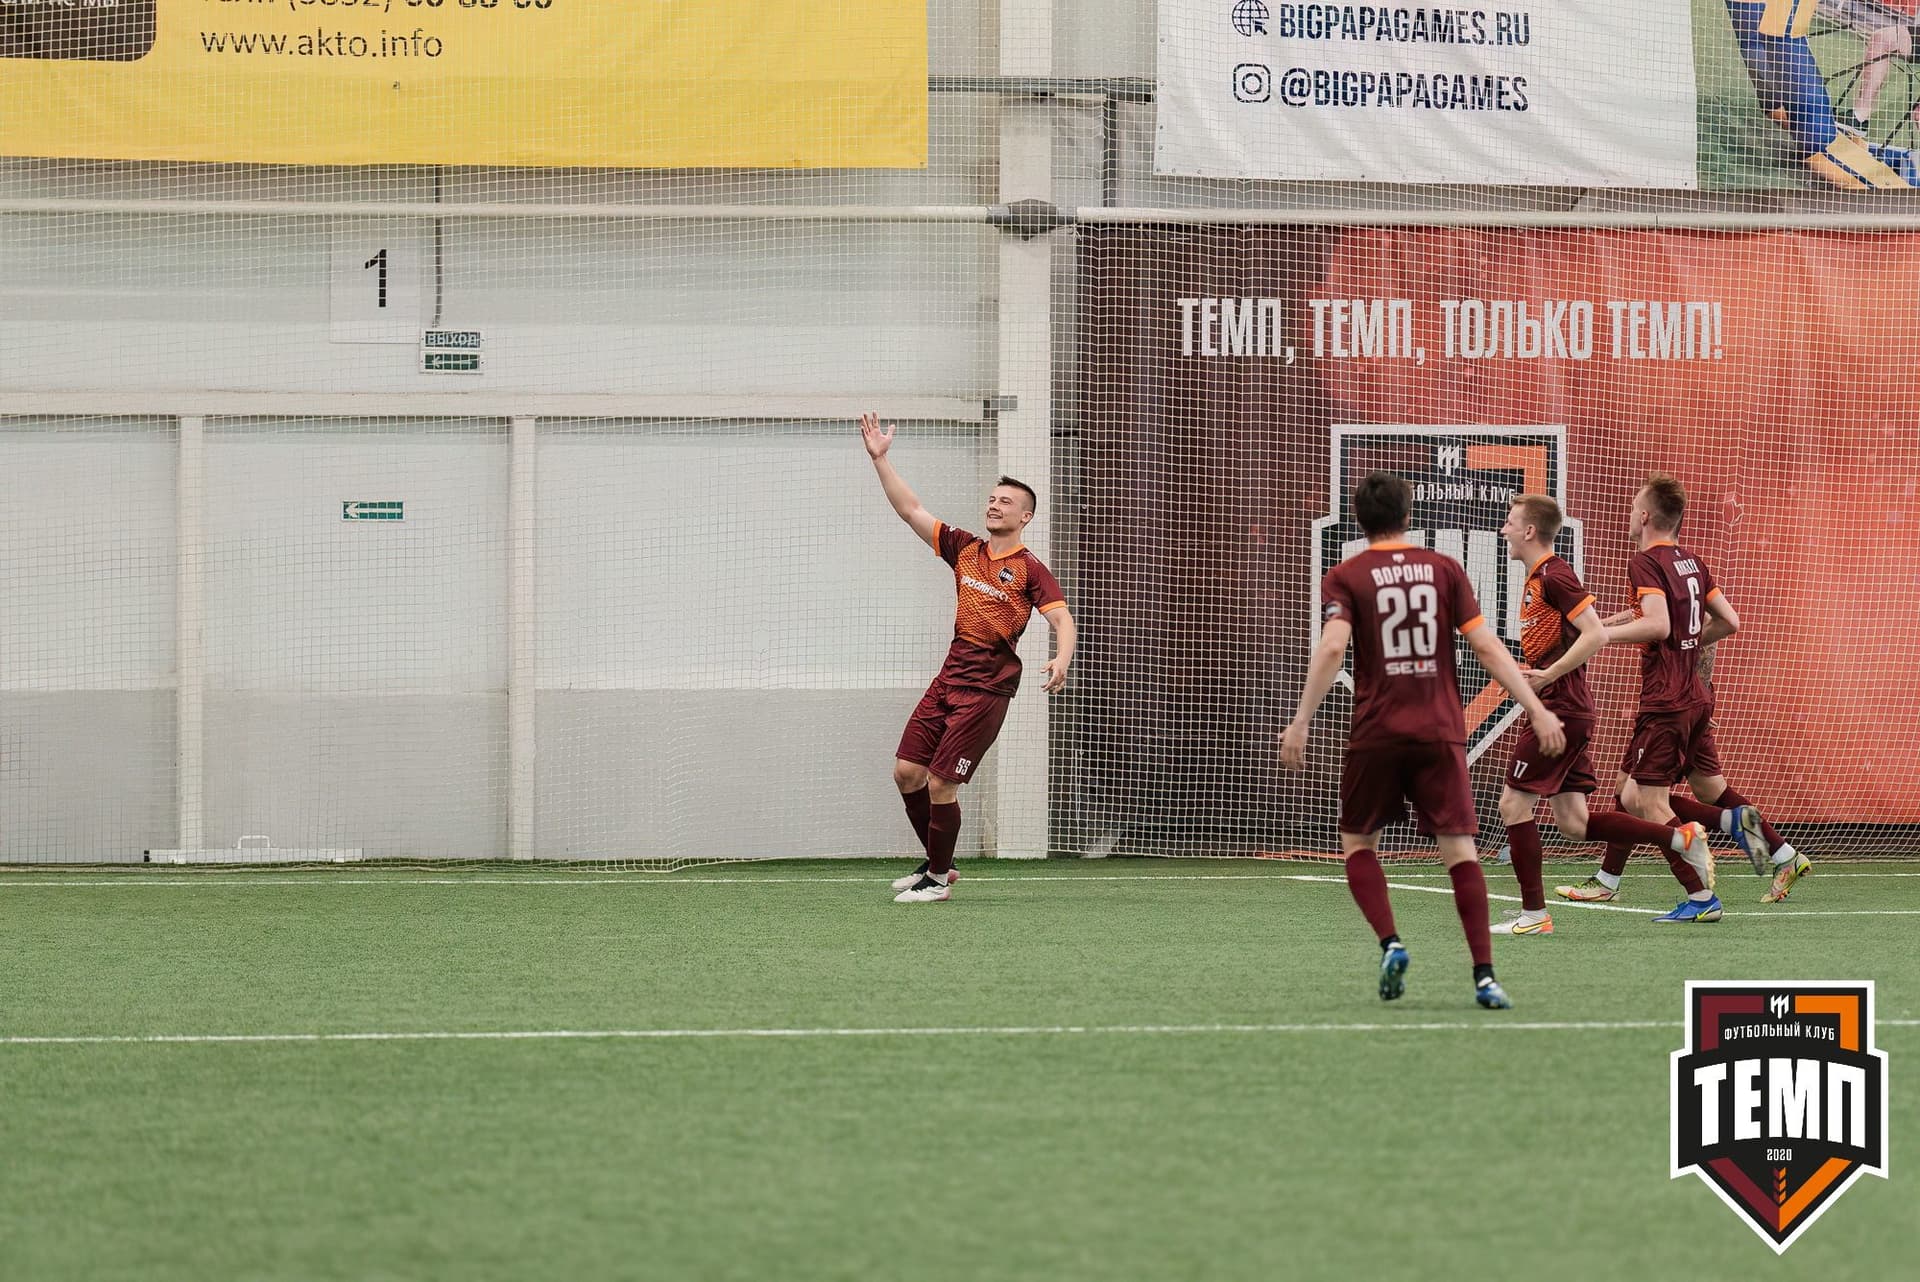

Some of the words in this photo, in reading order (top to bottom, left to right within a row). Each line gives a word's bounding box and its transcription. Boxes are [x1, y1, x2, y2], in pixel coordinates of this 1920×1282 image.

[200, 27, 443, 57] www.akto.info
[1280, 4, 1530, 46] BIGPAPAGAMES.RU
[1281, 68, 1529, 111] @BIGPAPAGAMES
[364, 249, 387, 307] 1
[427, 334, 478, 346] ВЫХОД
[1176, 299, 1296, 365] ТЕМП,
[1309, 300, 1426, 365] ТЕМП,
[1439, 300, 1593, 360] ТОЛЬКО
[1607, 301, 1723, 360] ТЕМП!
[1371, 564, 1434, 586] ВОРОНА
[1376, 583, 1438, 658] 23
[1687, 577, 1701, 635] 6
[1385, 660, 1437, 676] SEUS
[1513, 760, 1528, 779] 17
